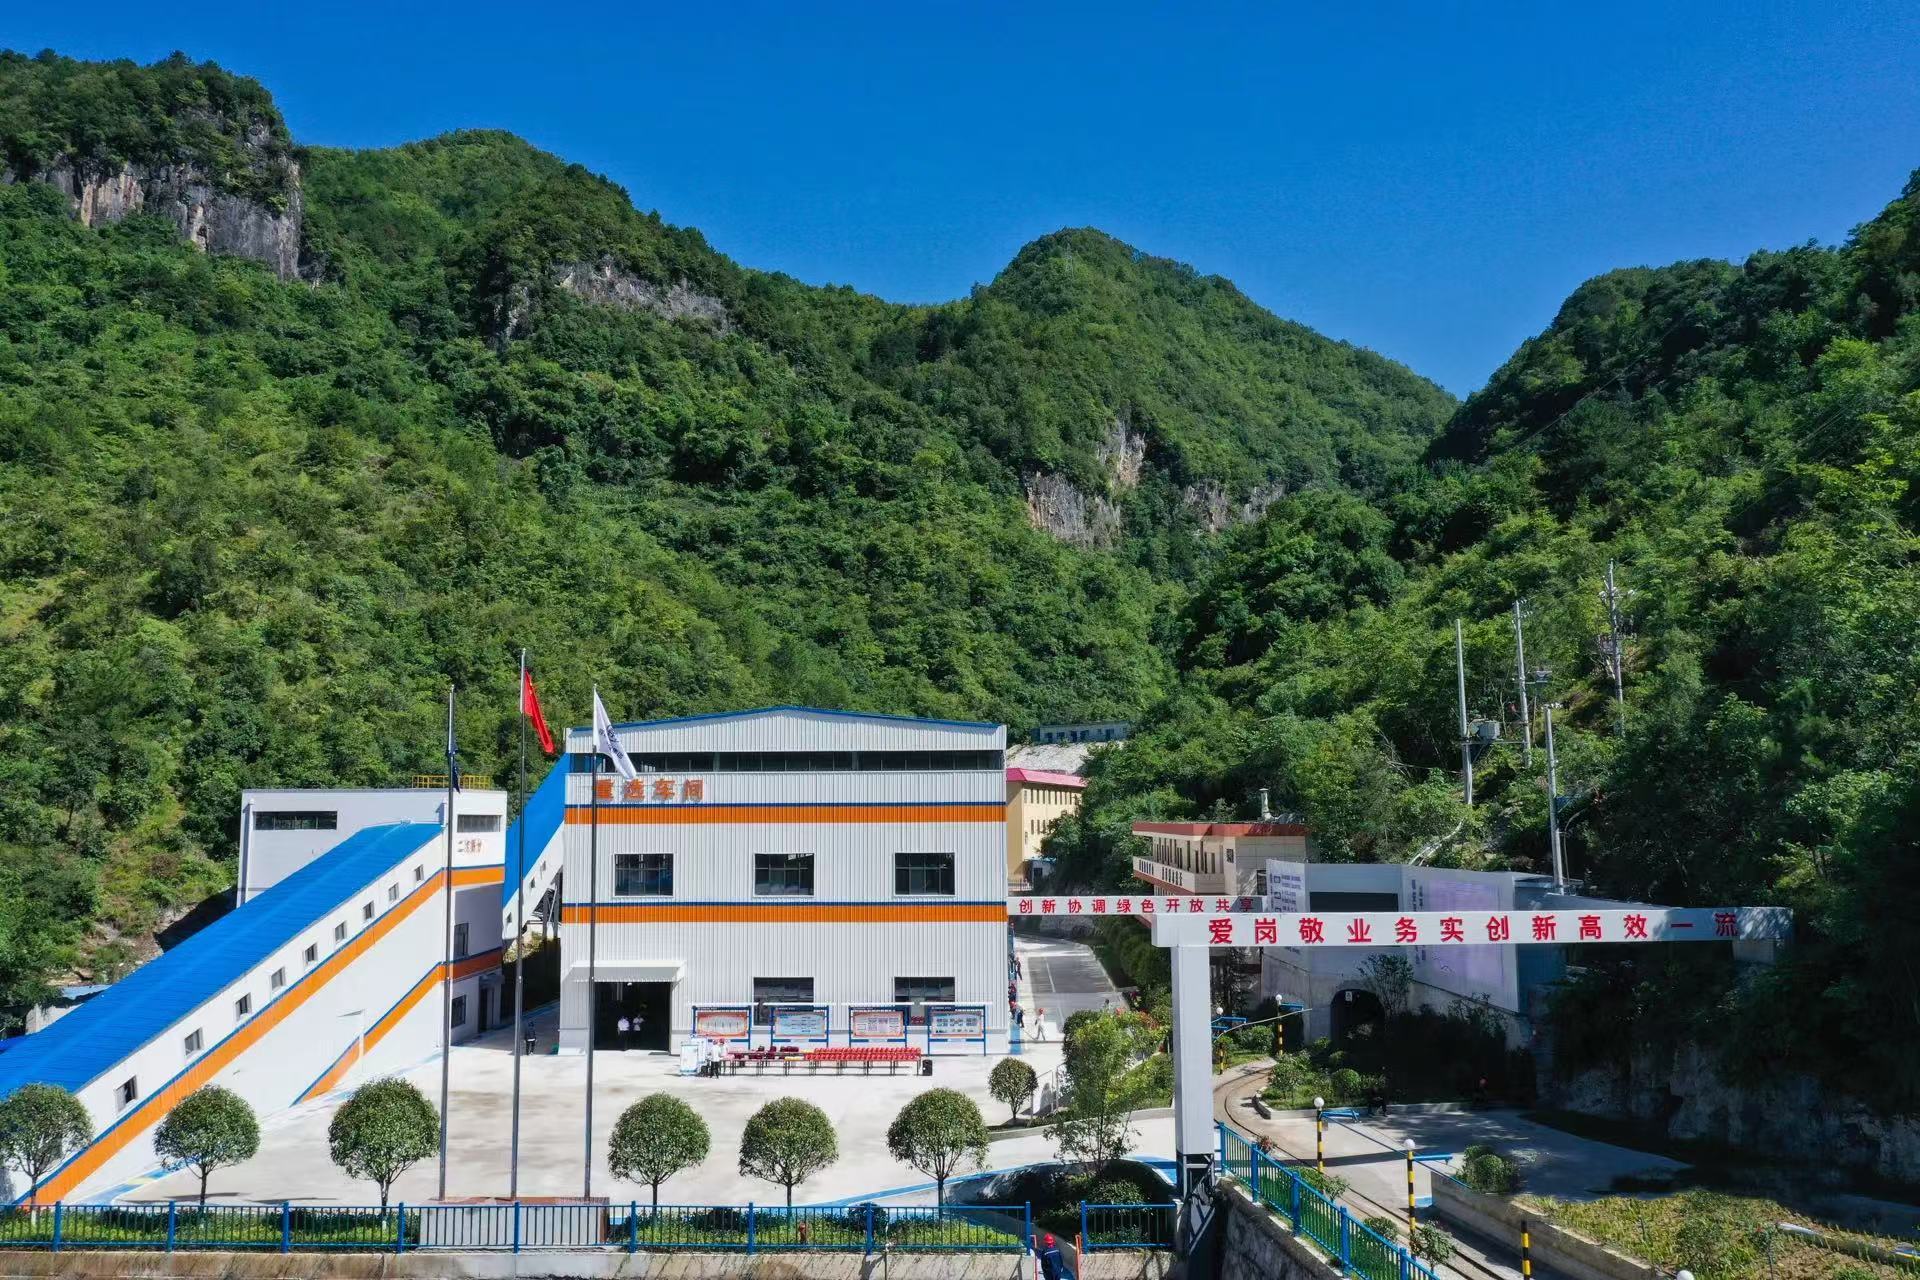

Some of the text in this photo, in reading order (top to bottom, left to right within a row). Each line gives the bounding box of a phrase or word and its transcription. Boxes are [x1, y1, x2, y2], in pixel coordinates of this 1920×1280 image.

[1019, 899, 1254, 913] 创新协调绿色开放共享
[1208, 913, 1740, 944] 爱岗敬业务实创新高效一流
